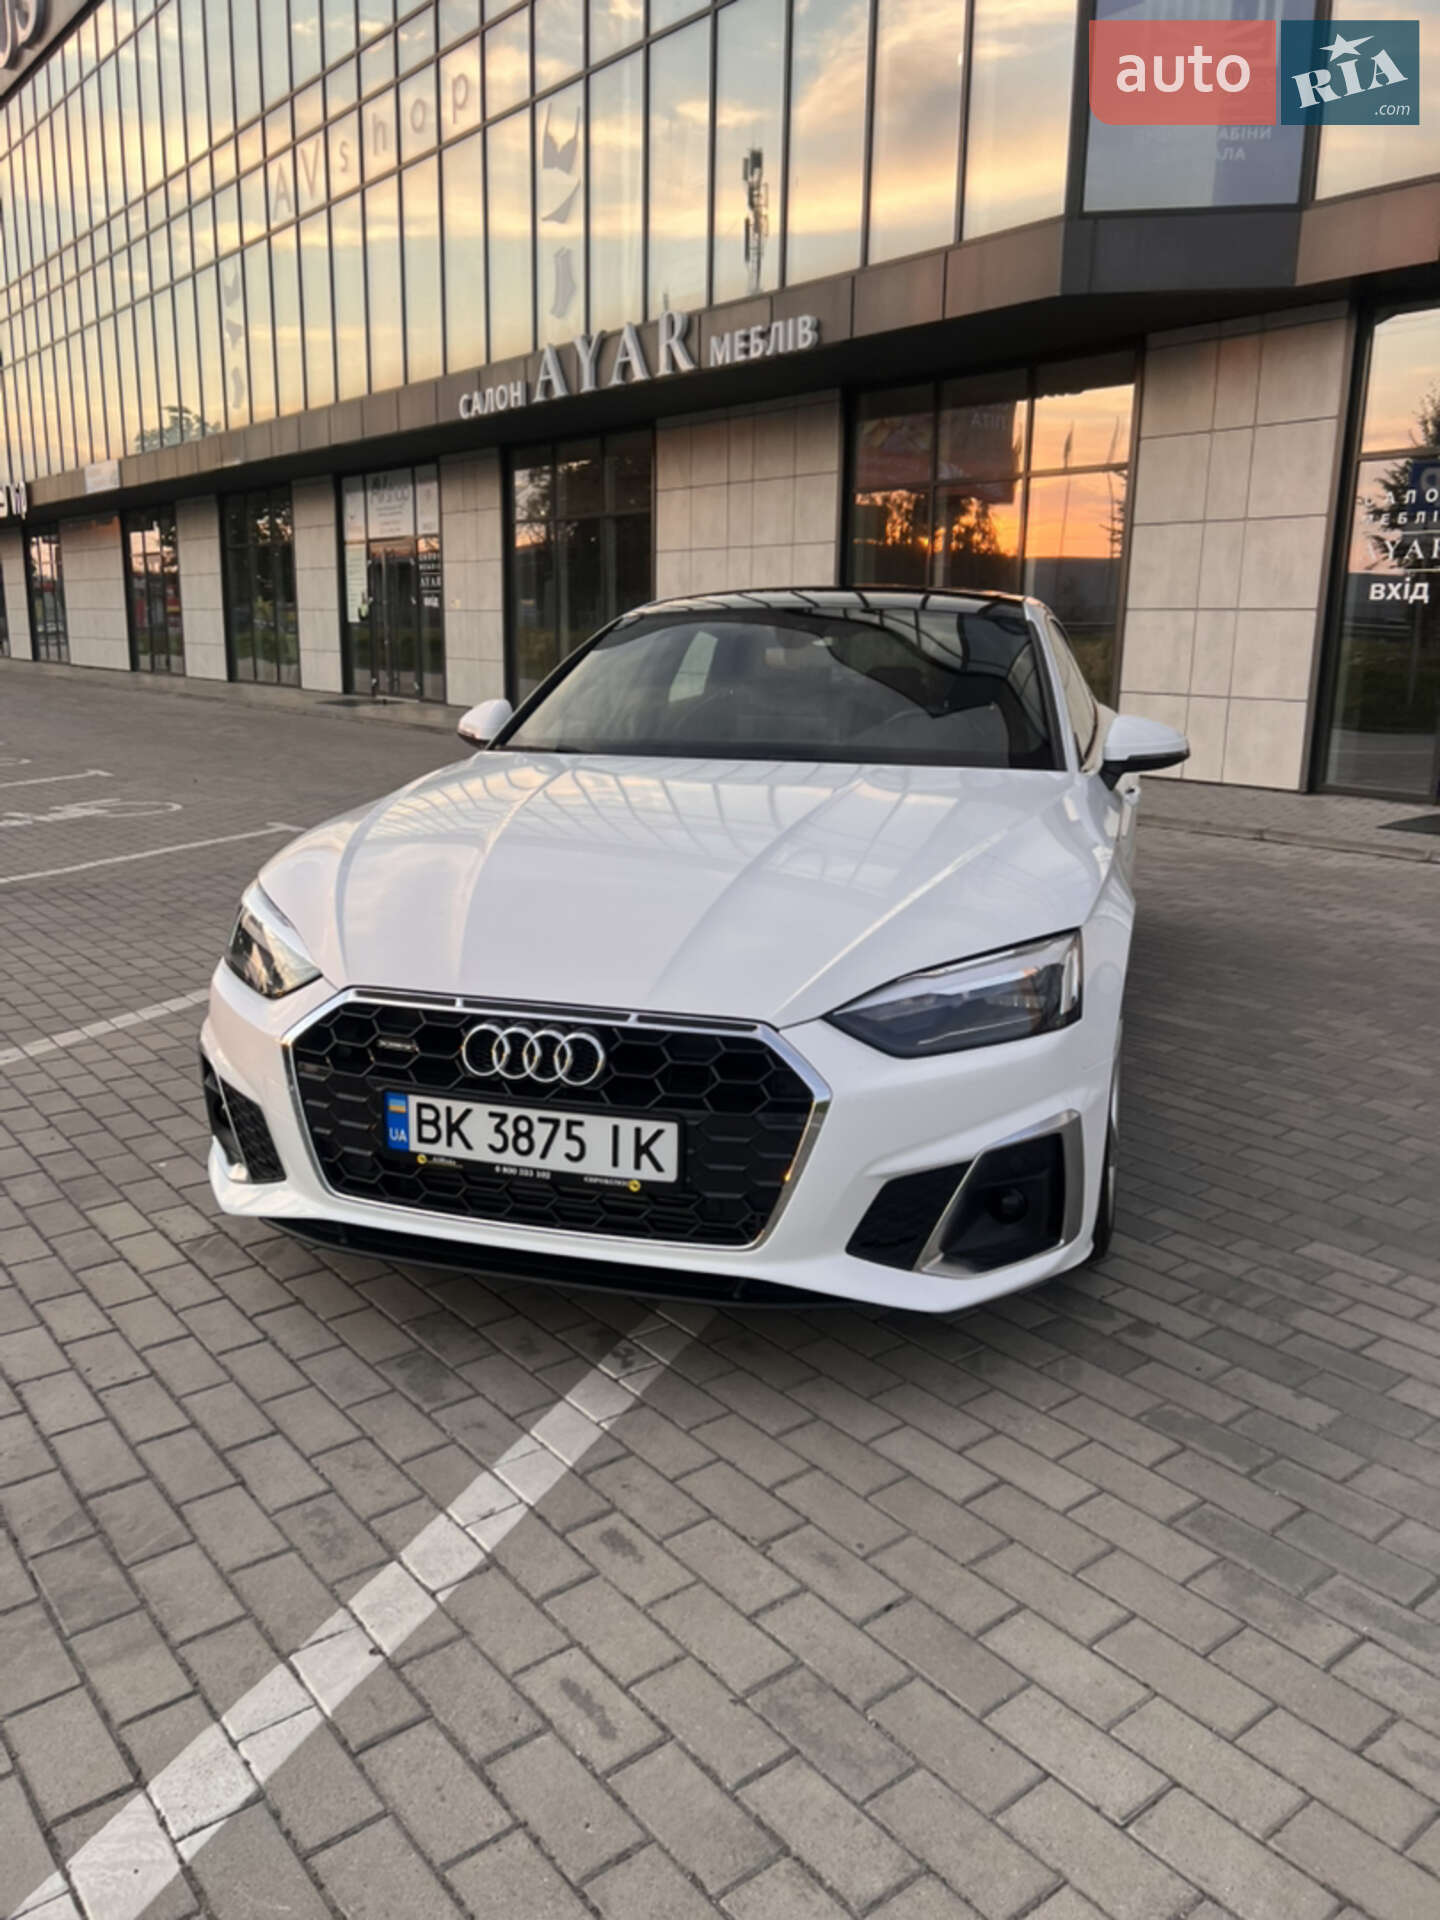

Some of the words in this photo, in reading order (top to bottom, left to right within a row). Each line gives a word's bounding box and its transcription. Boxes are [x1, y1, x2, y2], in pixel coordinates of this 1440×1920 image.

[459, 380, 527, 419] САЛОН
[533, 311, 697, 402] AYAR
[708, 315, 819, 367] МЕБЛІВ
[389, 1128, 407, 1143] UA
[416, 1101, 474, 1151] BK
[487, 1110, 586, 1163] 3875
[611, 1123, 665, 1173] IK
